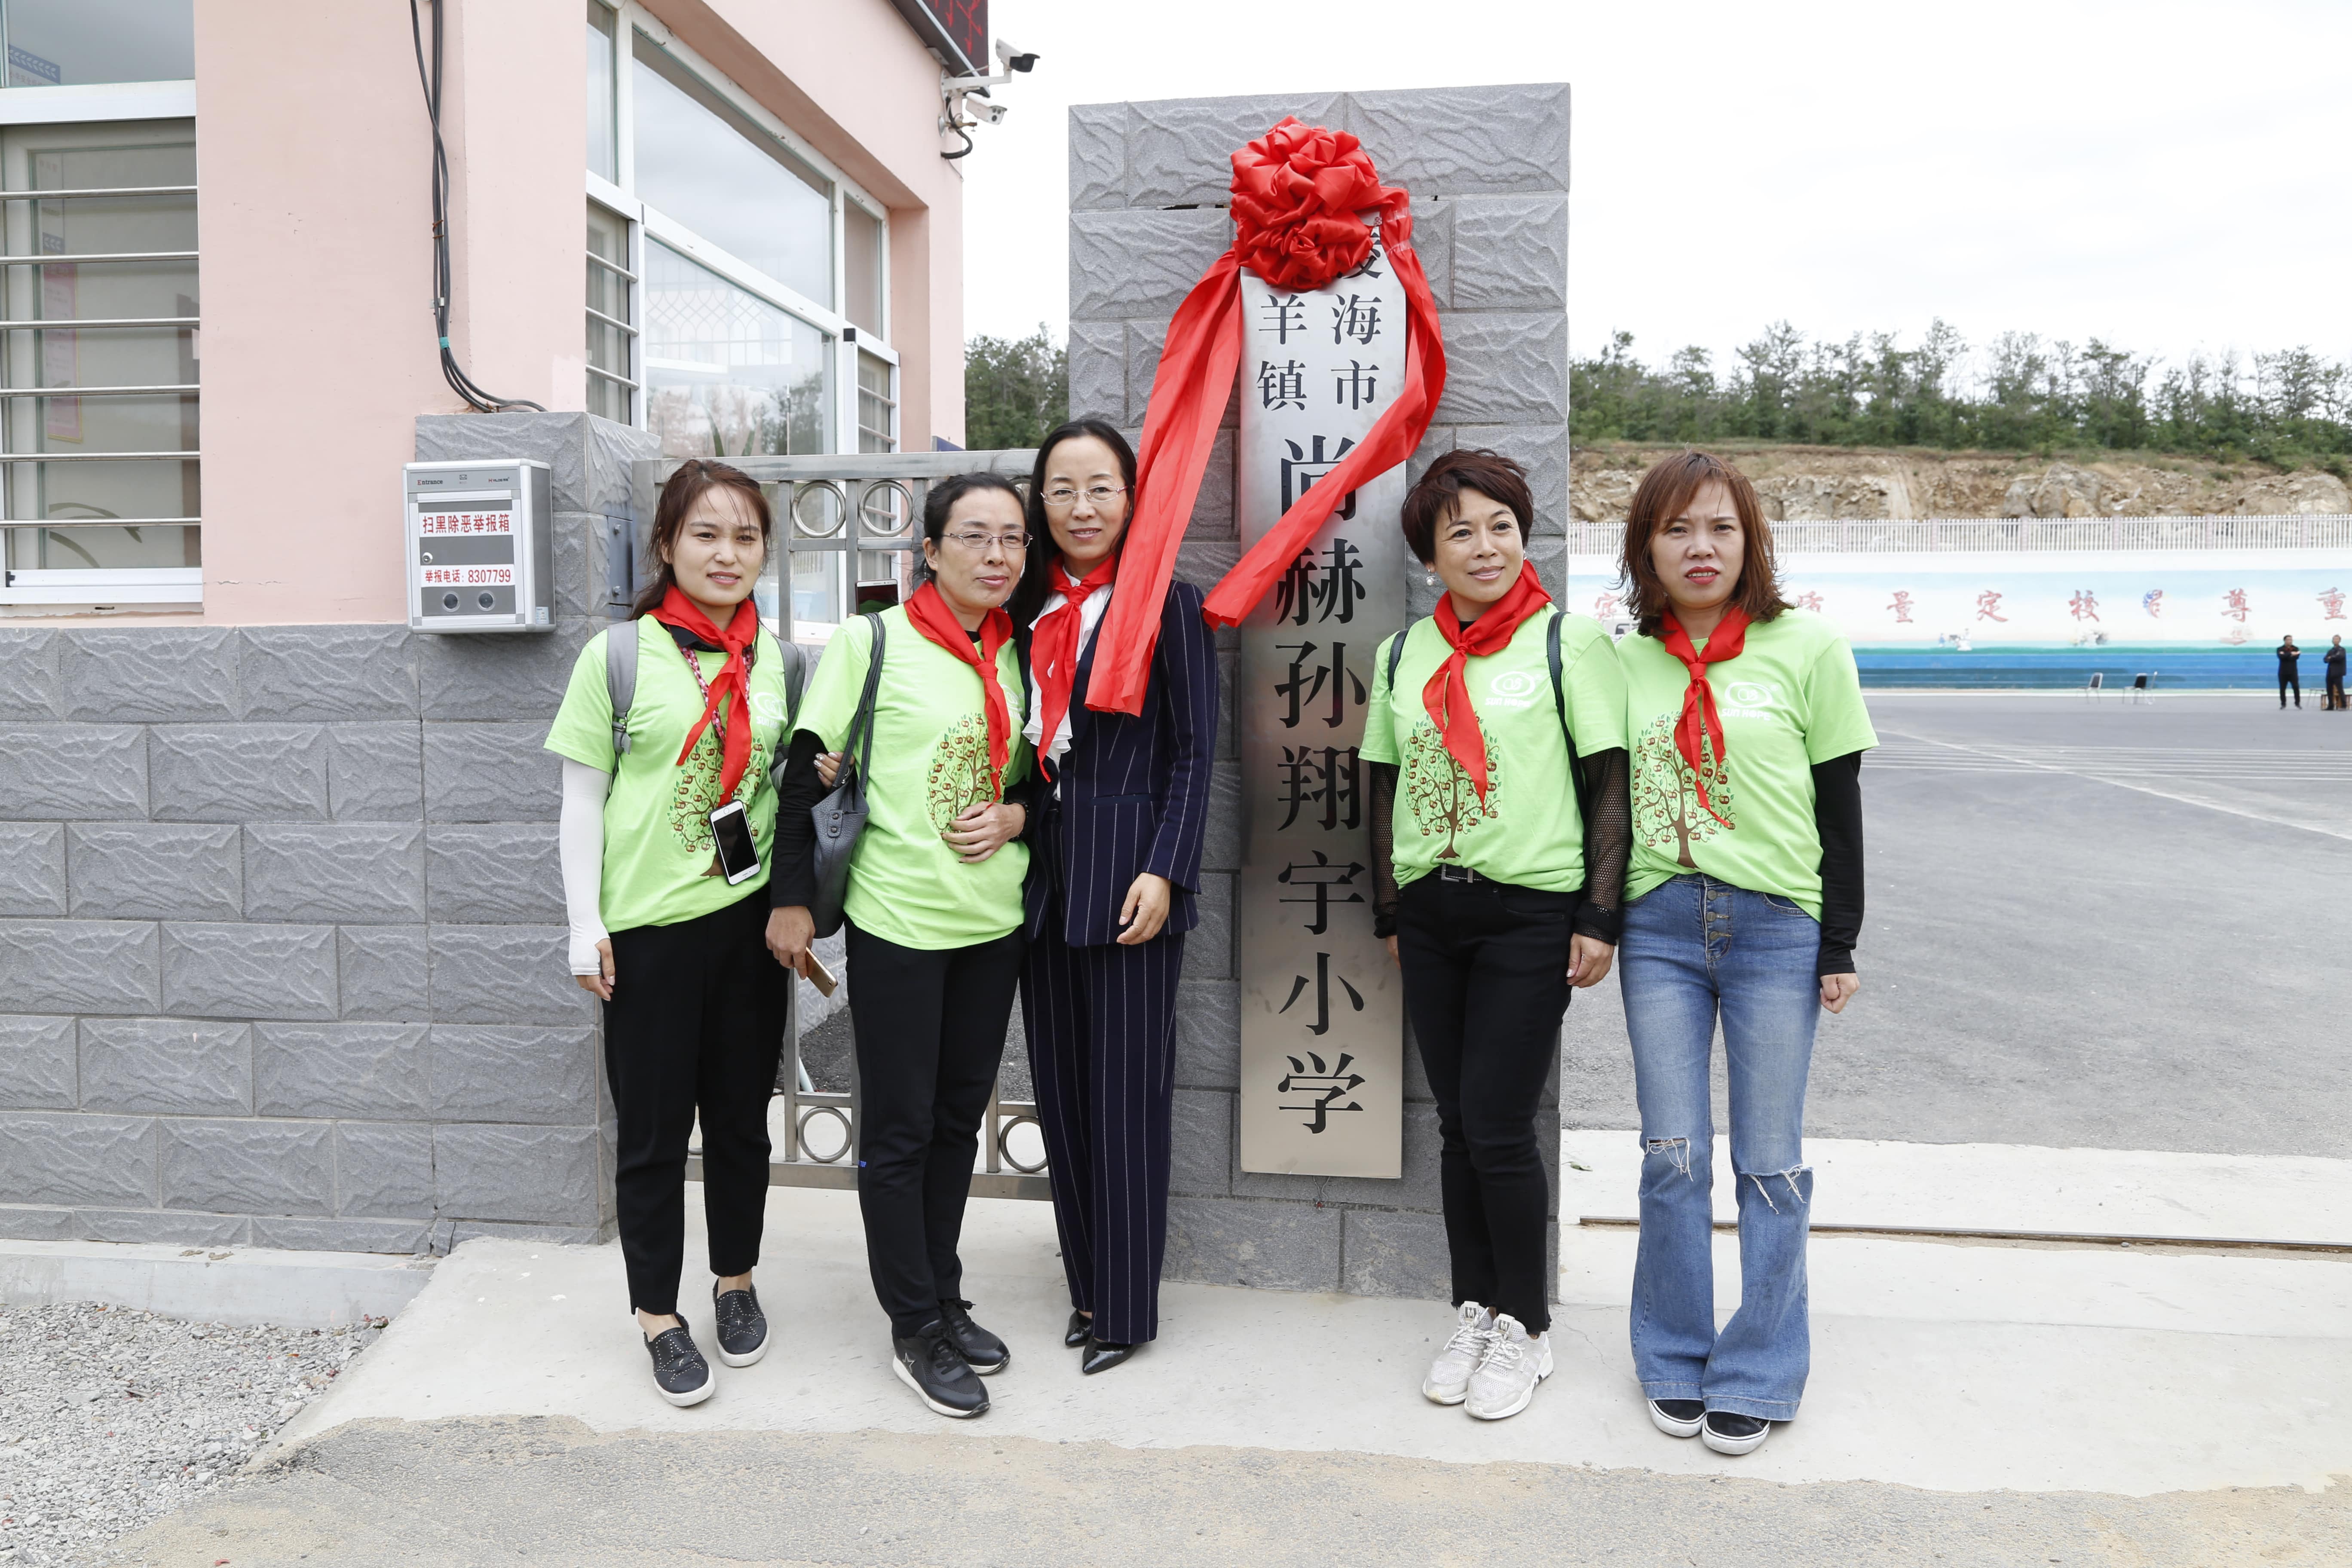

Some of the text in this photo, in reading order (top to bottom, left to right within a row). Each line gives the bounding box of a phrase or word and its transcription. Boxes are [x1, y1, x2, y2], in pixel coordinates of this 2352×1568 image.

[423, 514, 509, 533] 扫黑除恶举报箱
[1505, 698, 1531, 707] HOPE
[1742, 709, 1771, 721] HOPE
